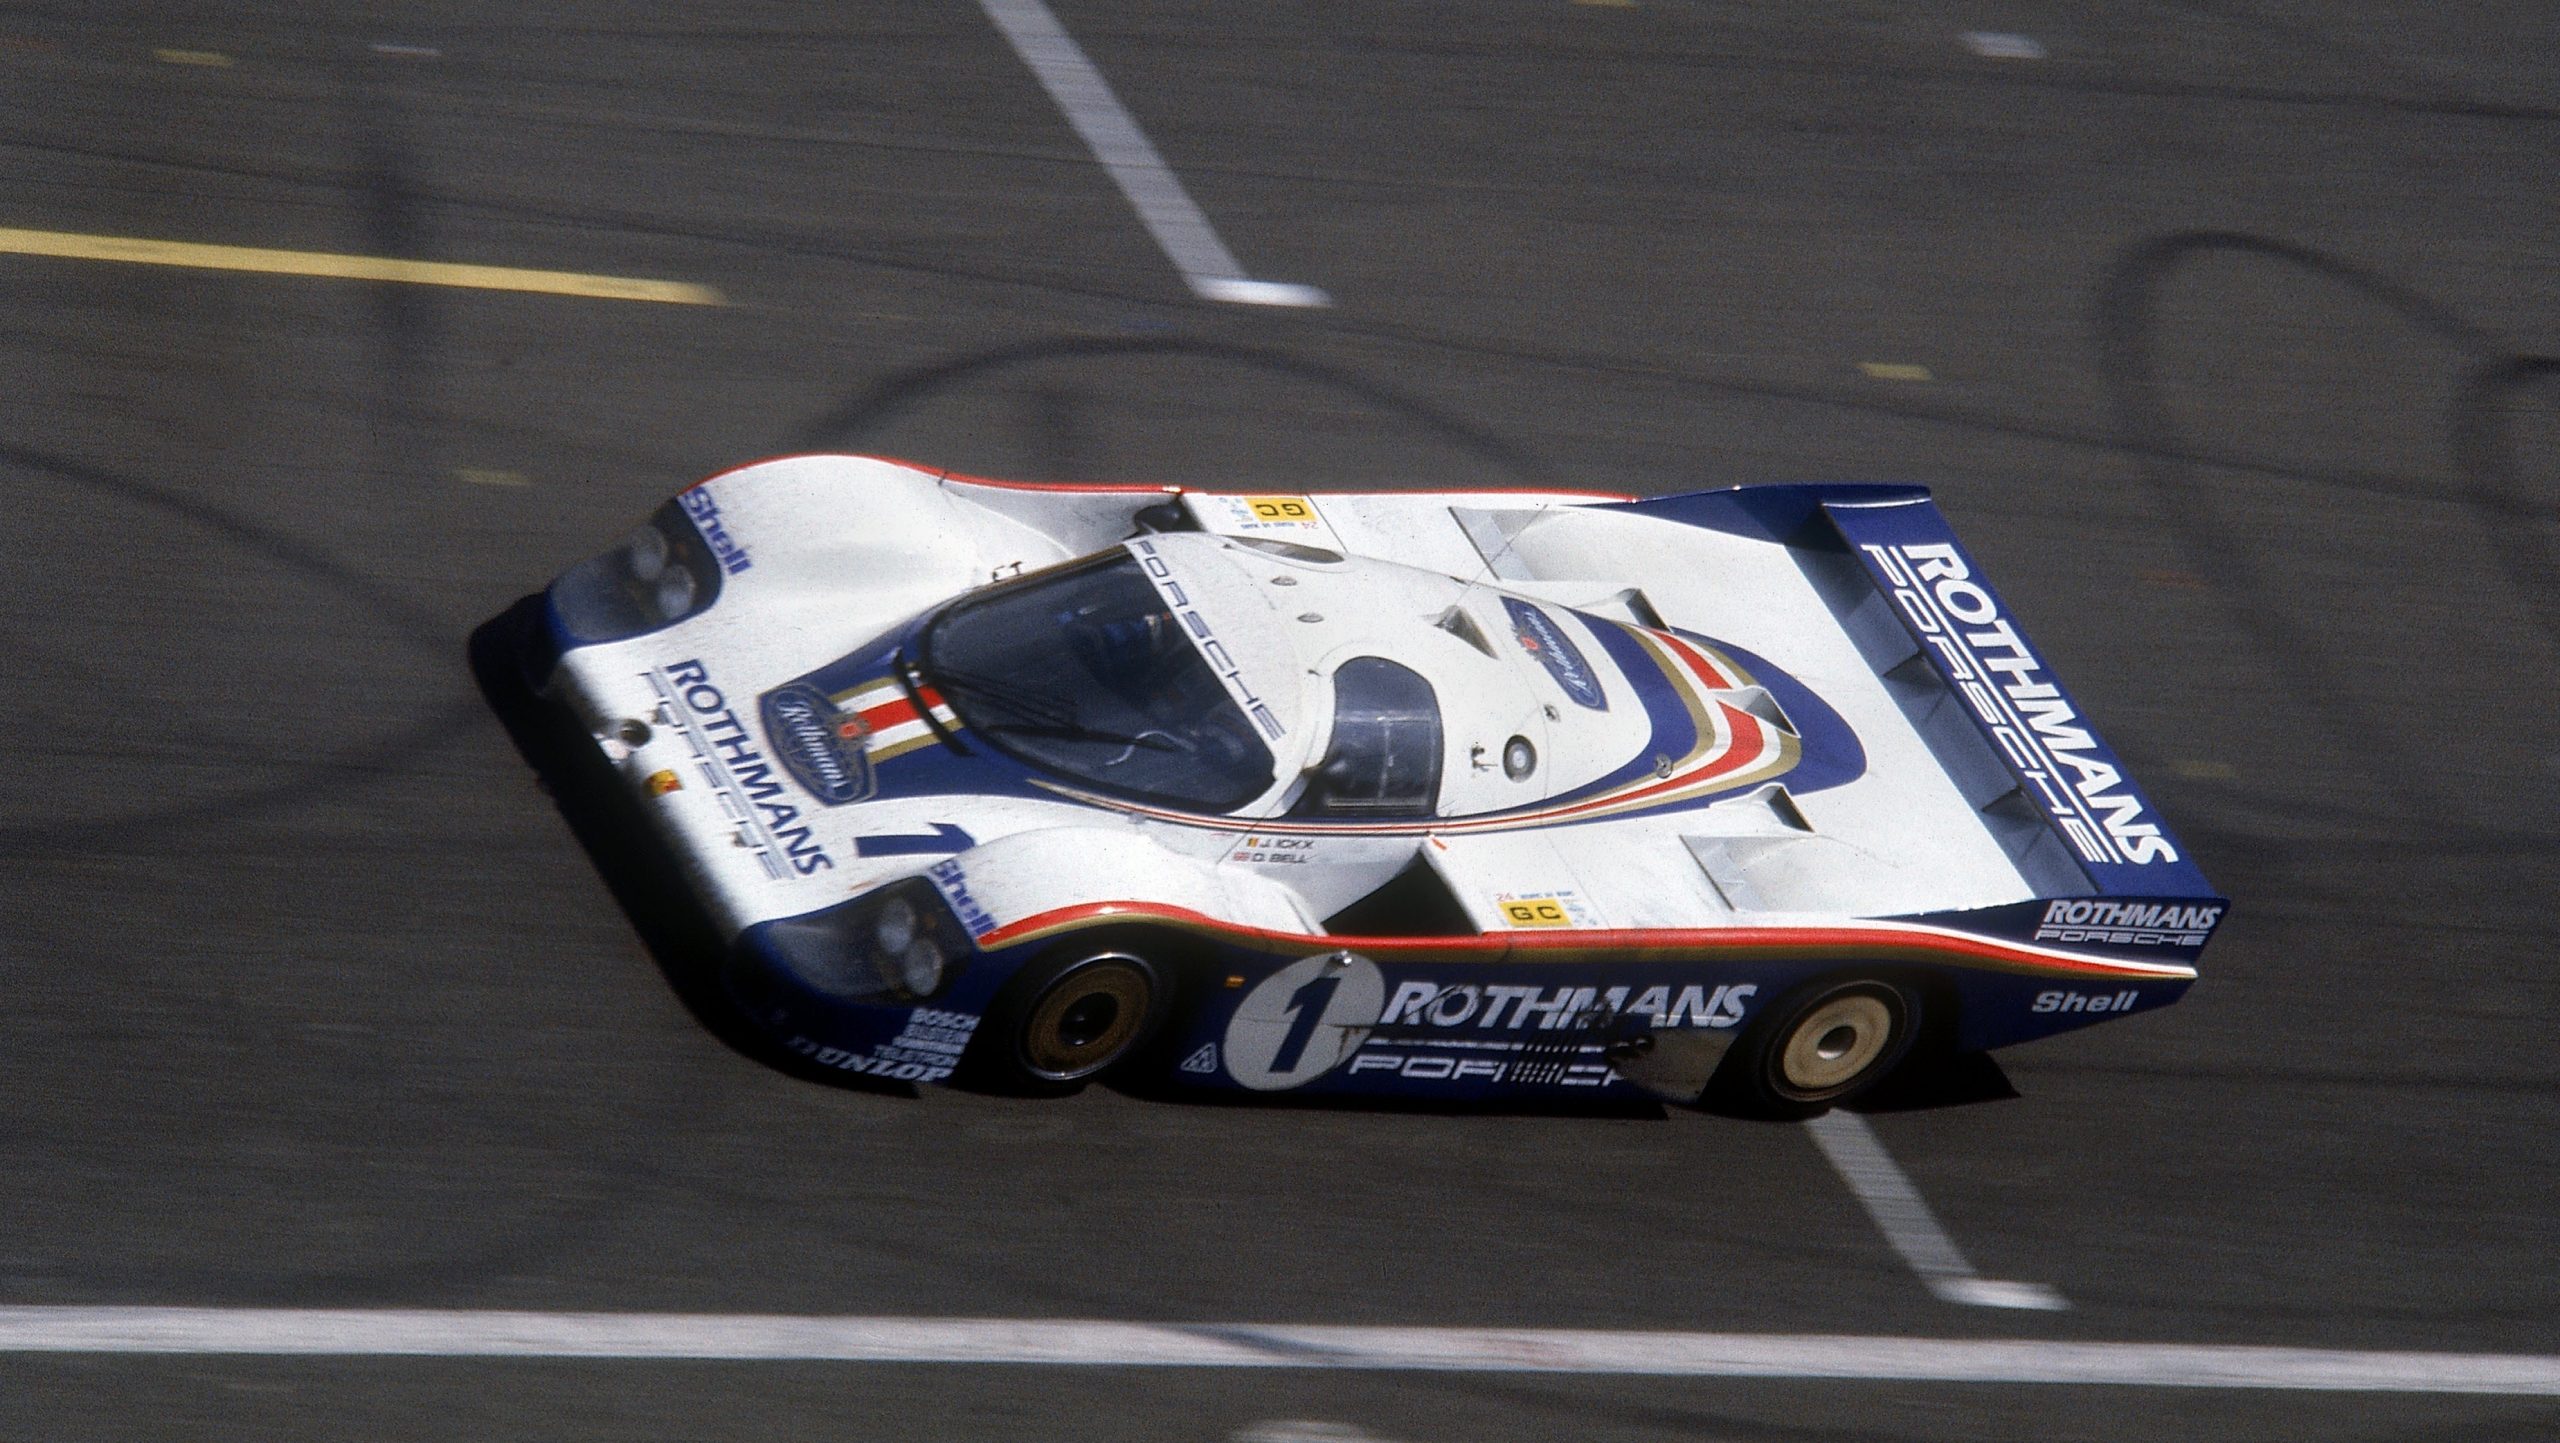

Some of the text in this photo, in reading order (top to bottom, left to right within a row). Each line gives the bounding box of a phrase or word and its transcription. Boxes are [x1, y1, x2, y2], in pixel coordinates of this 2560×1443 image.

[684, 486, 752, 575] Shell
[1135, 541, 1287, 741] PORSCHE
[1861, 544, 2109, 863] PORSCHE
[1903, 543, 2178, 865] ROTHMANS
[665, 658, 833, 876] ROTHMANS
[854, 822, 976, 858] 1
[933, 858, 997, 935] Shell
[2043, 899, 2222, 930] ROTHMANS
[2034, 929, 2206, 946] PORSCHE
[1268, 976, 1342, 1074] 1
[1379, 980, 1758, 1030] ROTHMANS
[2031, 990, 2140, 1013] Shell
[785, 1035, 954, 1082] DUNLOP
